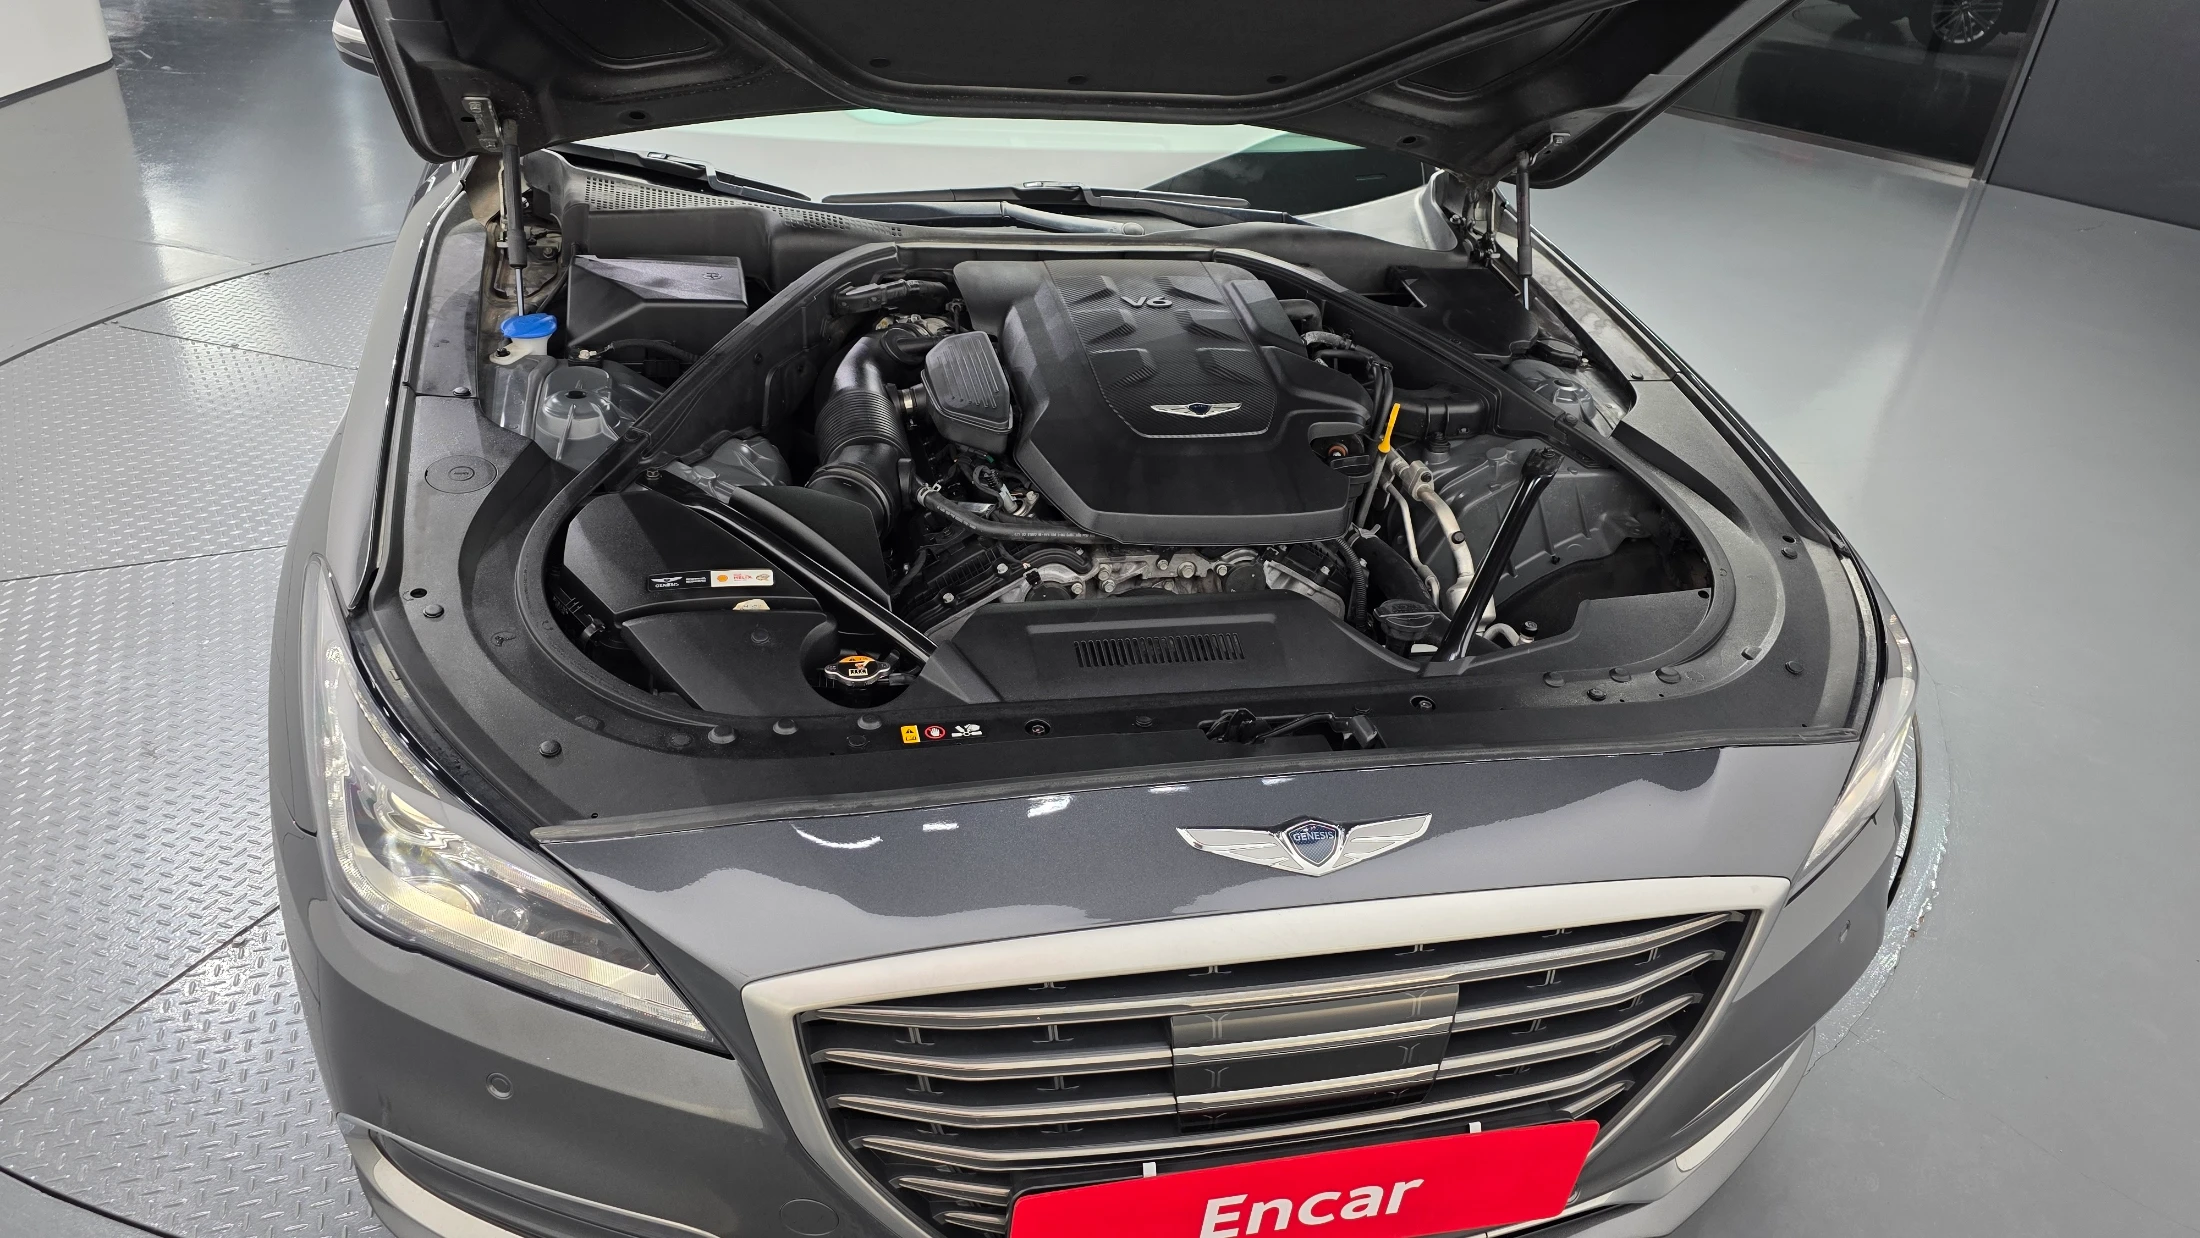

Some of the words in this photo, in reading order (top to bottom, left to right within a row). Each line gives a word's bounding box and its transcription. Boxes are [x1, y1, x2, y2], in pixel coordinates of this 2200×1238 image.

[1120, 296, 1173, 309] V6
[1292, 831, 1335, 841] GENESIS
[1199, 1179, 1425, 1238] Encar
